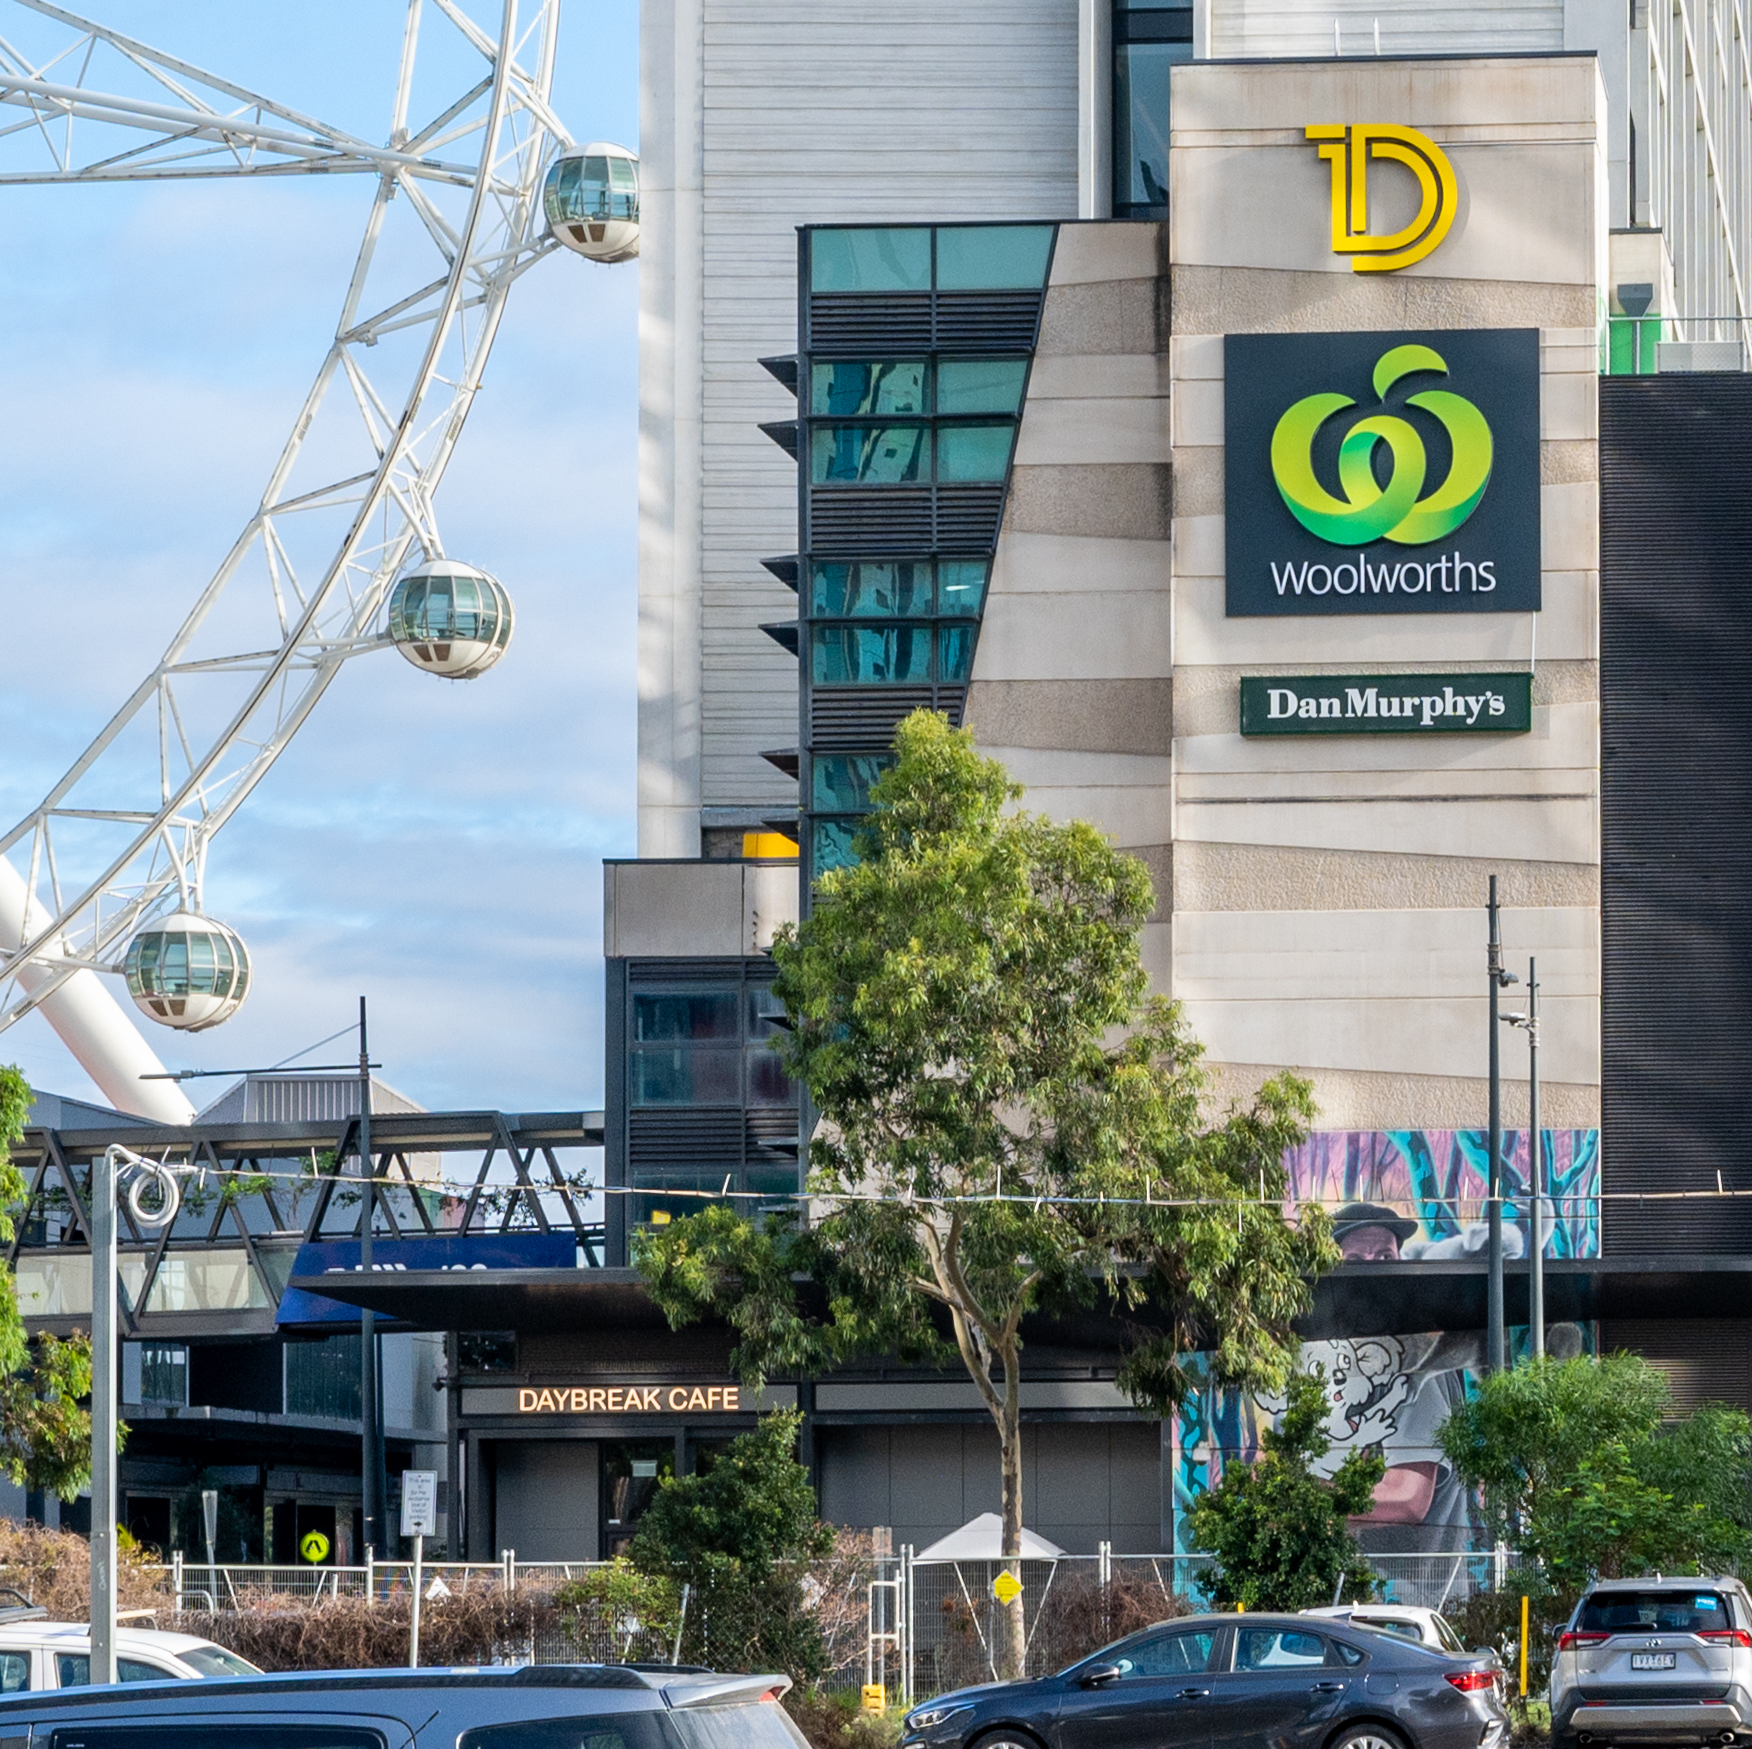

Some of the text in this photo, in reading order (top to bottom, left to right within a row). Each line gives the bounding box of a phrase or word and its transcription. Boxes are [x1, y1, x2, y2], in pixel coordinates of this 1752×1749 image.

[1270, 551, 1497, 595] Woolworths
[1267, 686, 1506, 726] Dan Murphy's
[518, 1386, 740, 1412] DAYBREAK CAFE
